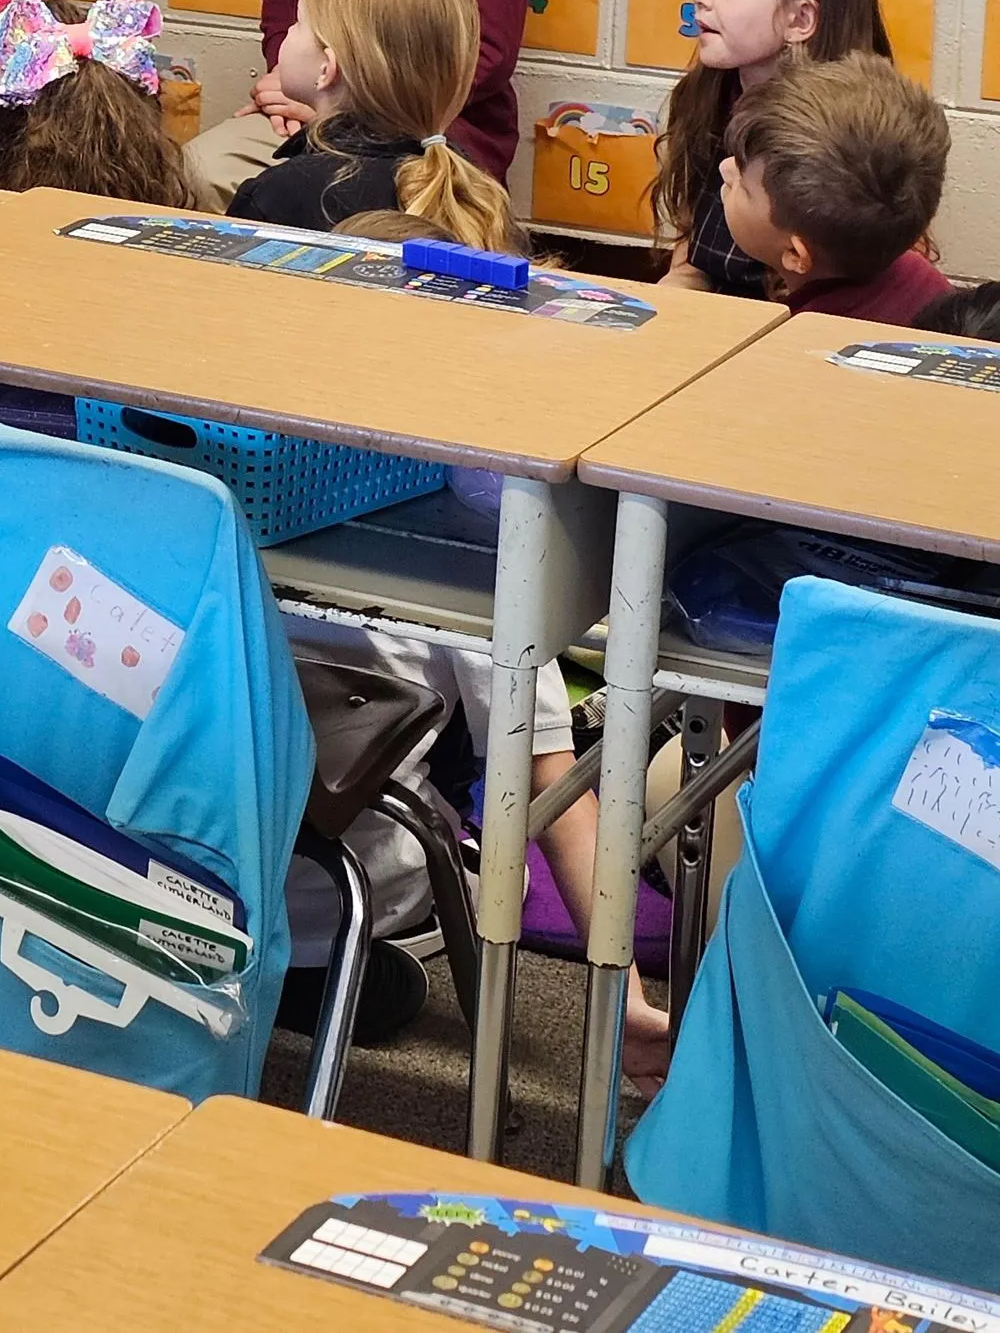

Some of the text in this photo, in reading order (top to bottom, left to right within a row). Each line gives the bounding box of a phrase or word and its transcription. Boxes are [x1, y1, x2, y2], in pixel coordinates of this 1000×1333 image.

[678, 2, 701, 37] 5
[569, 154, 611, 195] 15
[166, 875, 220, 905] CALETTE
[161, 929, 217, 952] CALETTE
[740, 1256, 859, 1295] Carter
[884, 1289, 988, 1333] Bailey
